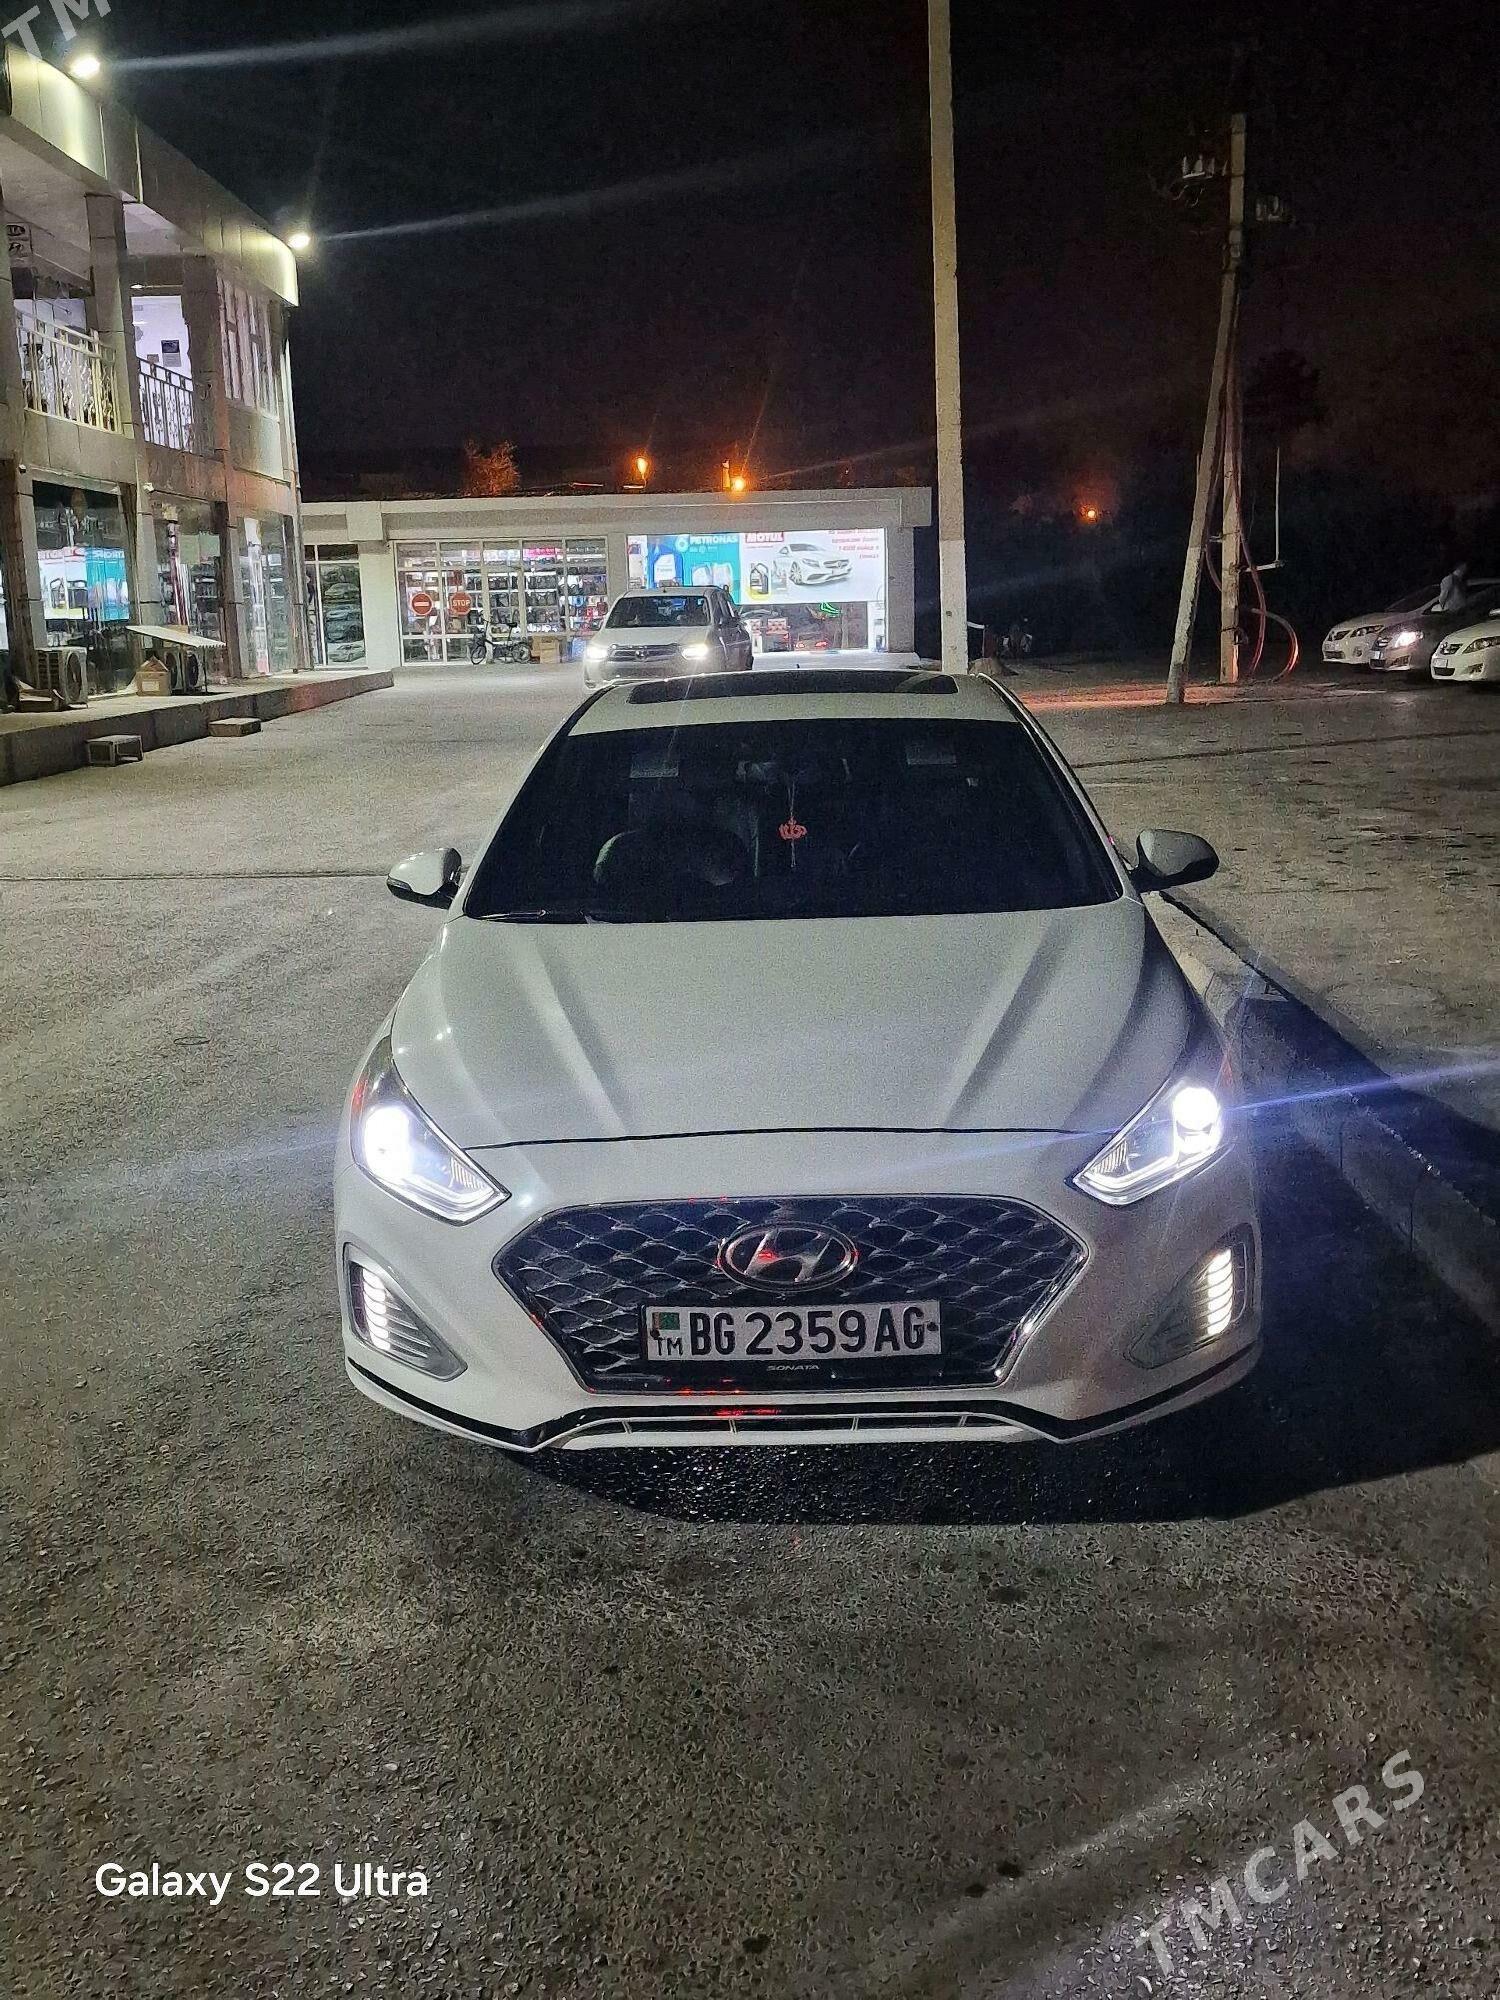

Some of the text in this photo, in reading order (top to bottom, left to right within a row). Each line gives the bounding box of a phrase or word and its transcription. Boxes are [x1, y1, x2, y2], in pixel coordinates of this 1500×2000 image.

[689, 534, 738, 545] PETRONAS
[747, 532, 783, 542] MOTUL
[689, 1307, 925, 1356] BG 2359 AG
[656, 1337, 683, 1356] TM
[766, 1364, 820, 1372] SONATA
